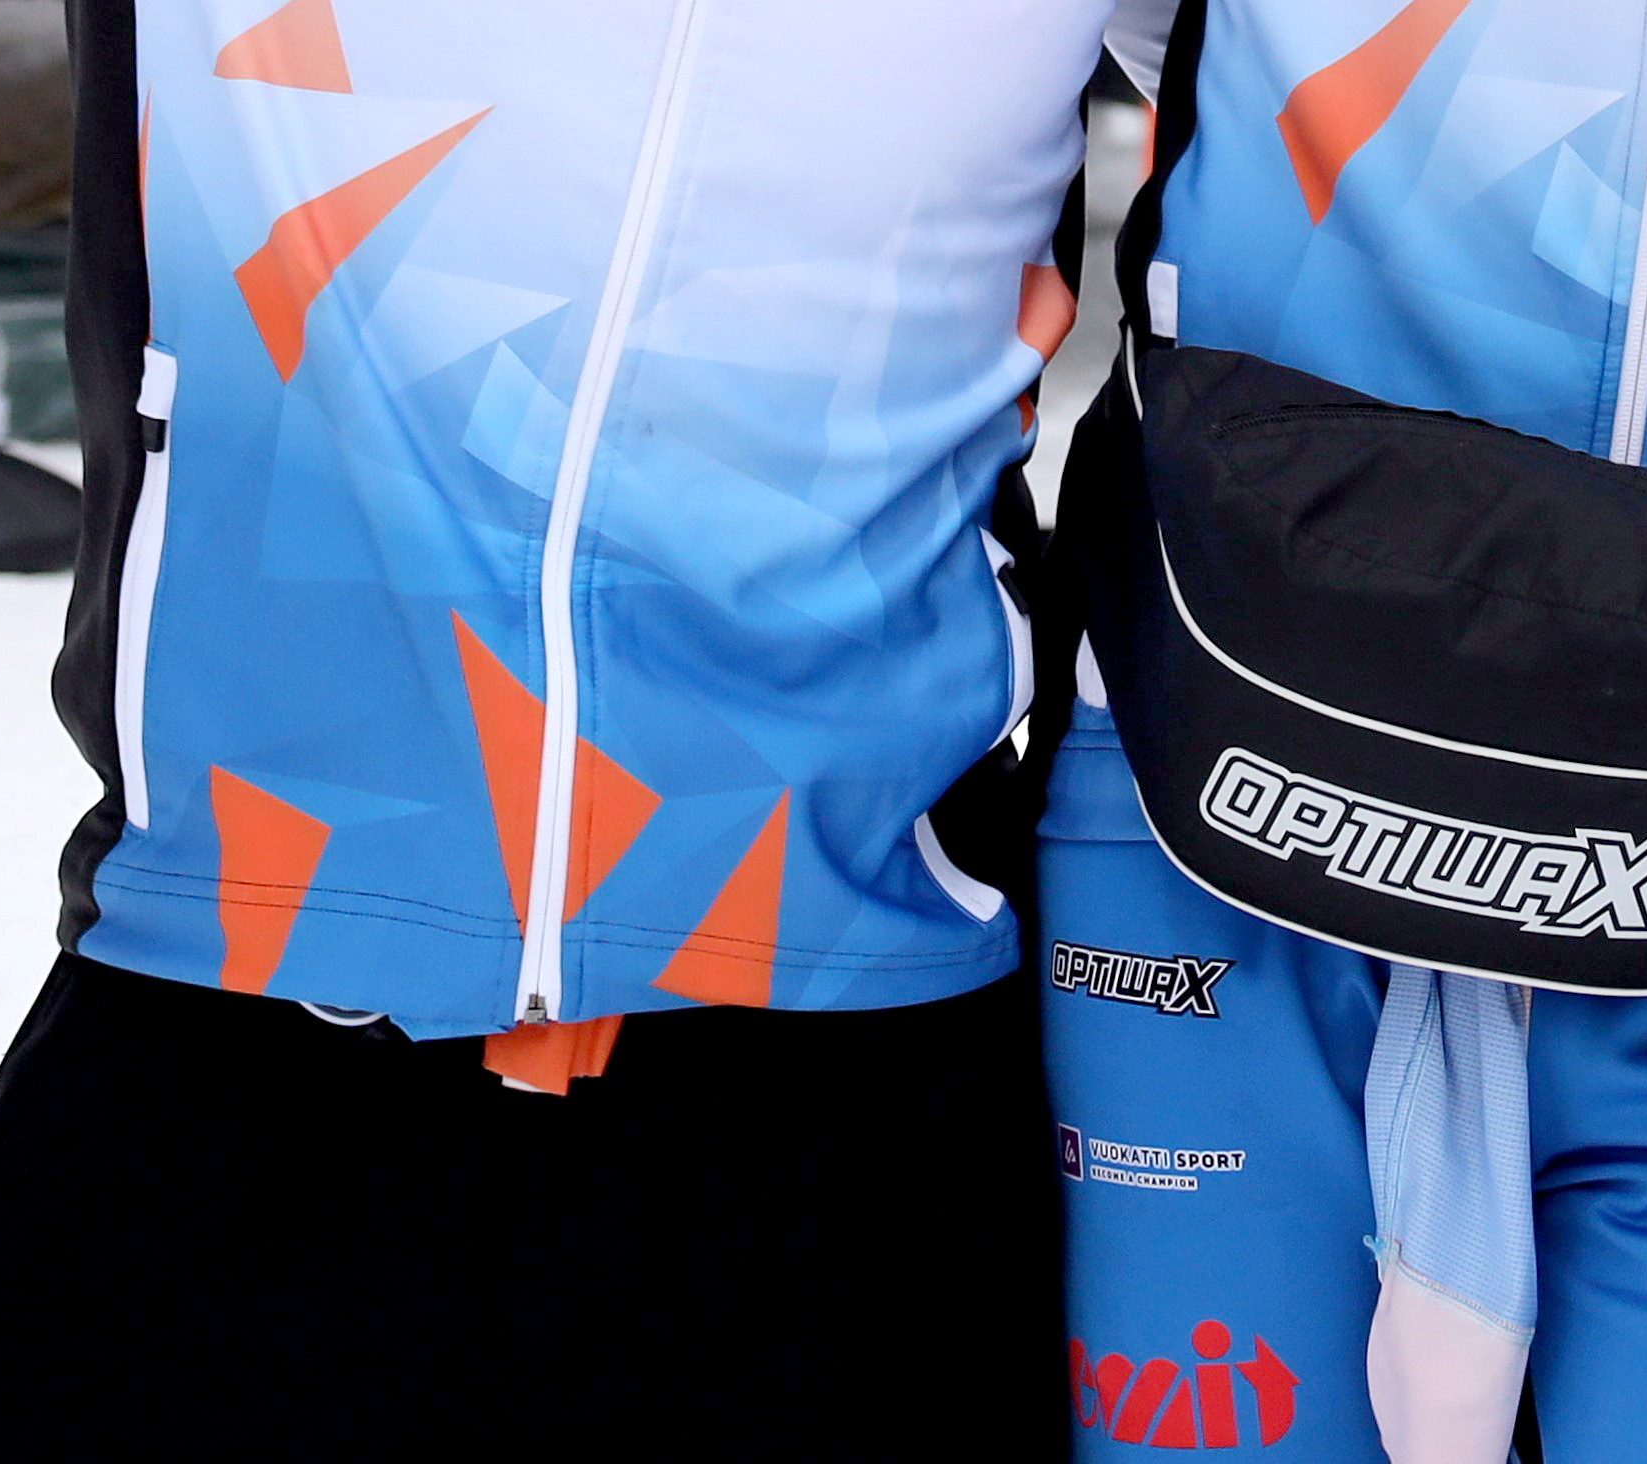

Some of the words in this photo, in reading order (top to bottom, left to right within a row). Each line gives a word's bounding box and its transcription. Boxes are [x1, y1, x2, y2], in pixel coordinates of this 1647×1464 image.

[1050, 940, 1237, 1019] OPTIWAX
[1089, 1139, 1170, 1168] VUOKATTI
[1175, 1151, 1245, 1171] SPORT
[1137, 1176, 1196, 1189] CHAMPION
